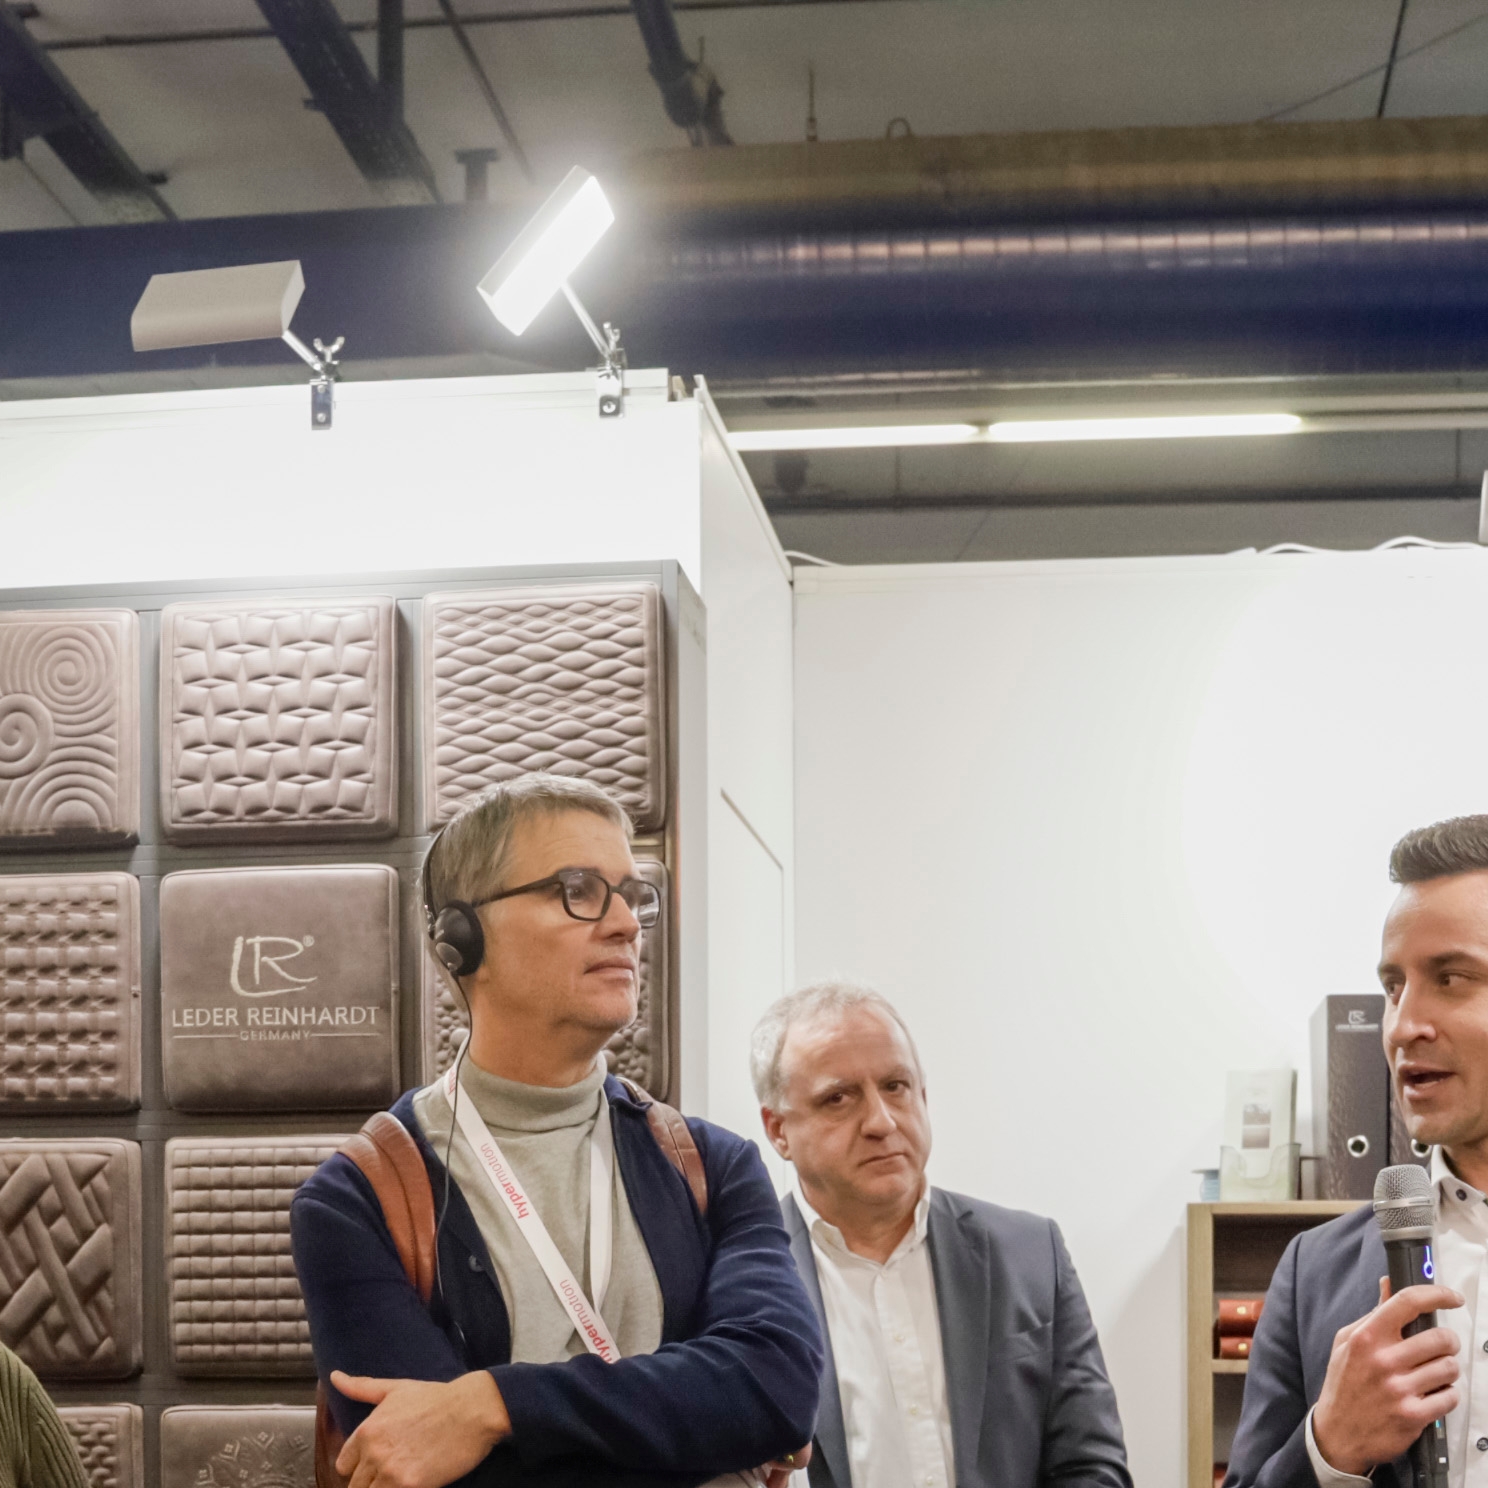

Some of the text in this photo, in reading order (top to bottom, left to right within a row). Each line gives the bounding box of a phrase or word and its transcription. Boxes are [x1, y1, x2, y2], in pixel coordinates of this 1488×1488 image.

[172, 1006, 380, 1028] LEDER REINHARDT
[240, 1029, 311, 1041] GERMANY
[480, 1143, 530, 1220] hypermotion
